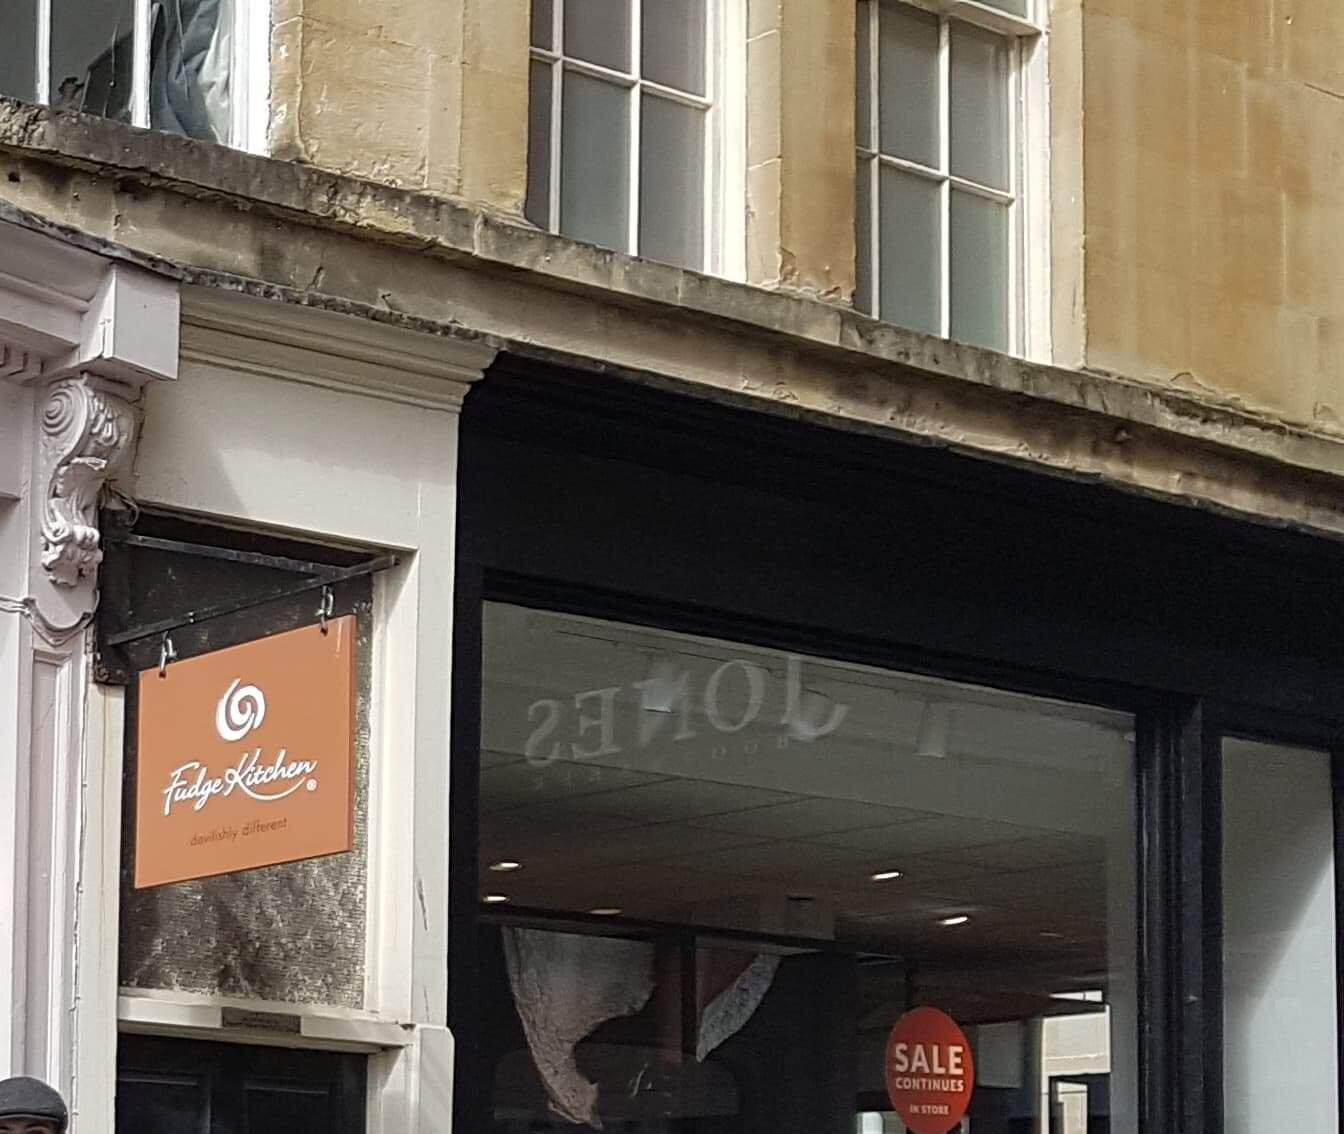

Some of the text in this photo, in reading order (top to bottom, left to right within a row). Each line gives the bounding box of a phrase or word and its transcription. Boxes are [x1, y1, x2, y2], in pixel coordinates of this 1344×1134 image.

[164, 748, 318, 816] Fudge Kitchen
[191, 817, 288, 847] devilishly different
[895, 1043, 964, 1075] SALE
[896, 1077, 964, 1092] CONTINUES
[921, 1104, 949, 1115] STORE
